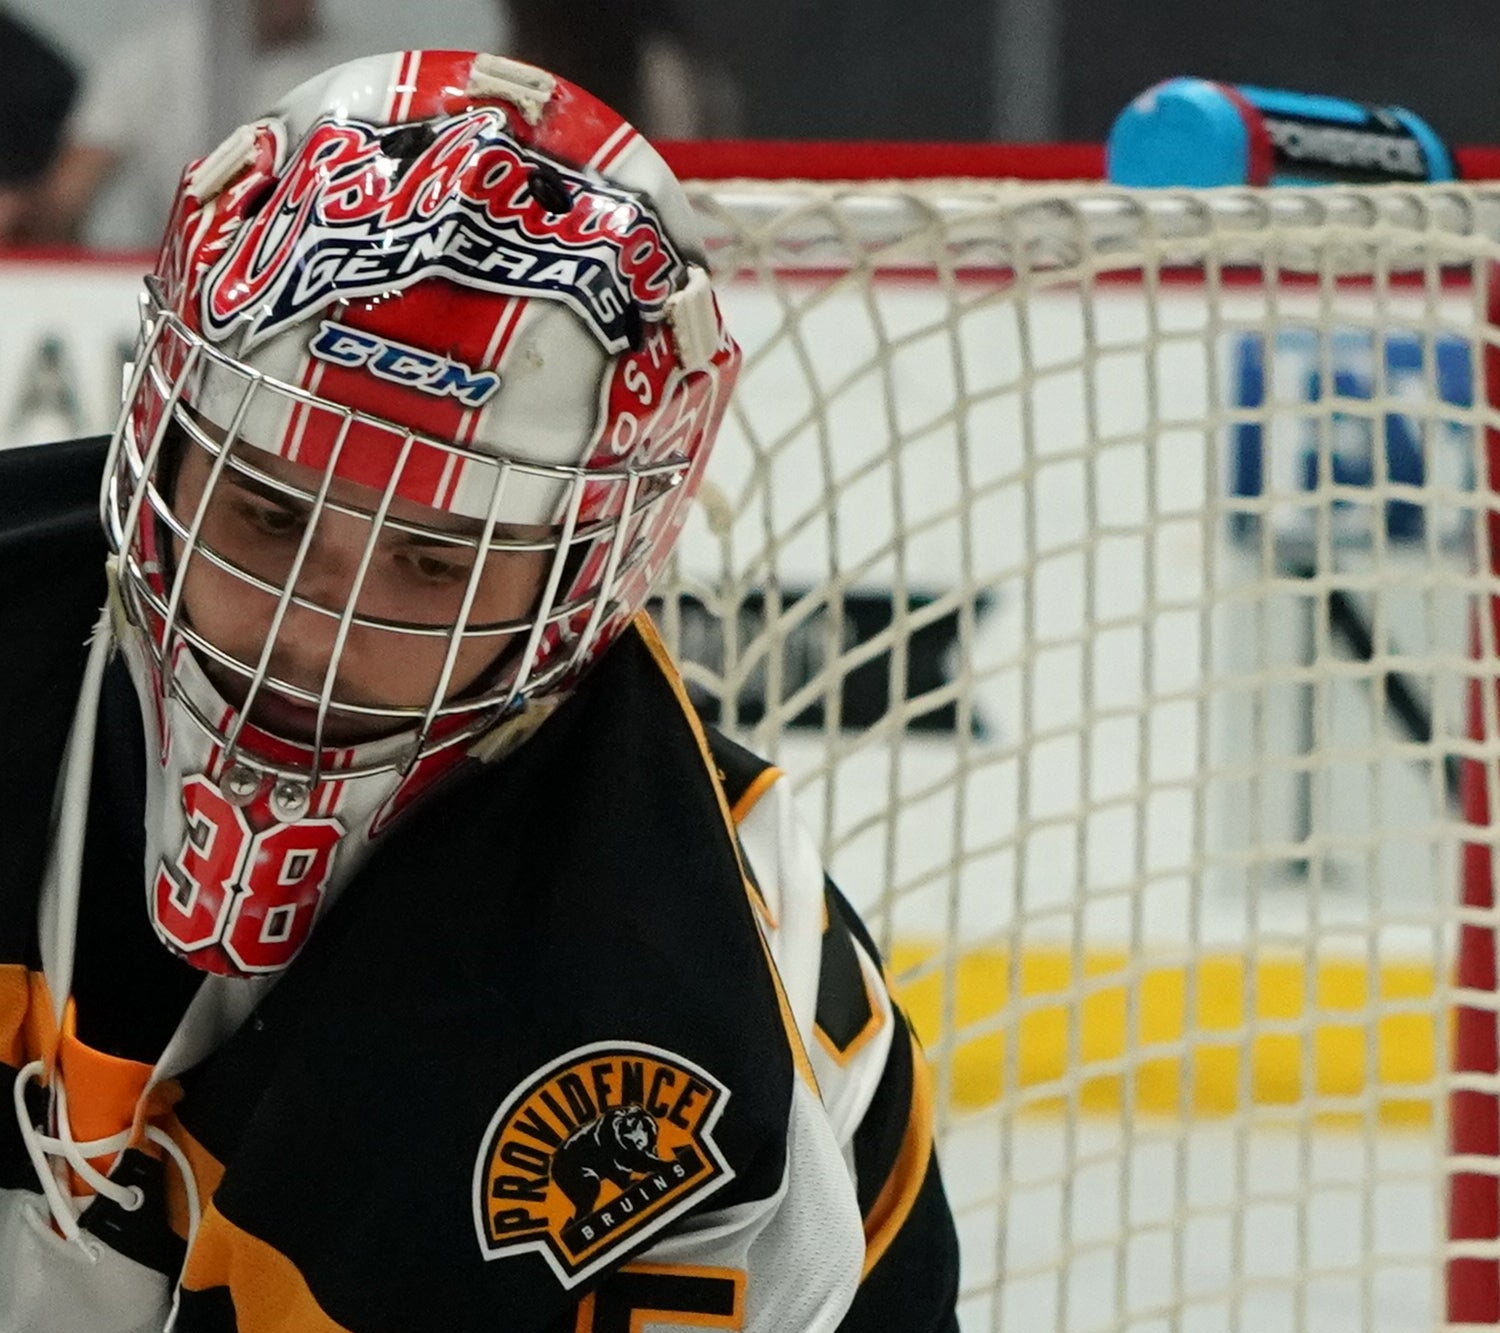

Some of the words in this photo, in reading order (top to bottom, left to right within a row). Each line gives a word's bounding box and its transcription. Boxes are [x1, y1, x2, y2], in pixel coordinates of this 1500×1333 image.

[306, 222, 626, 327] GENERALS
[309, 320, 500, 407] CCM
[153, 773, 346, 974] 38
[494, 1060, 717, 1235] PROVIDENCE
[580, 1162, 686, 1242] BRUINS
